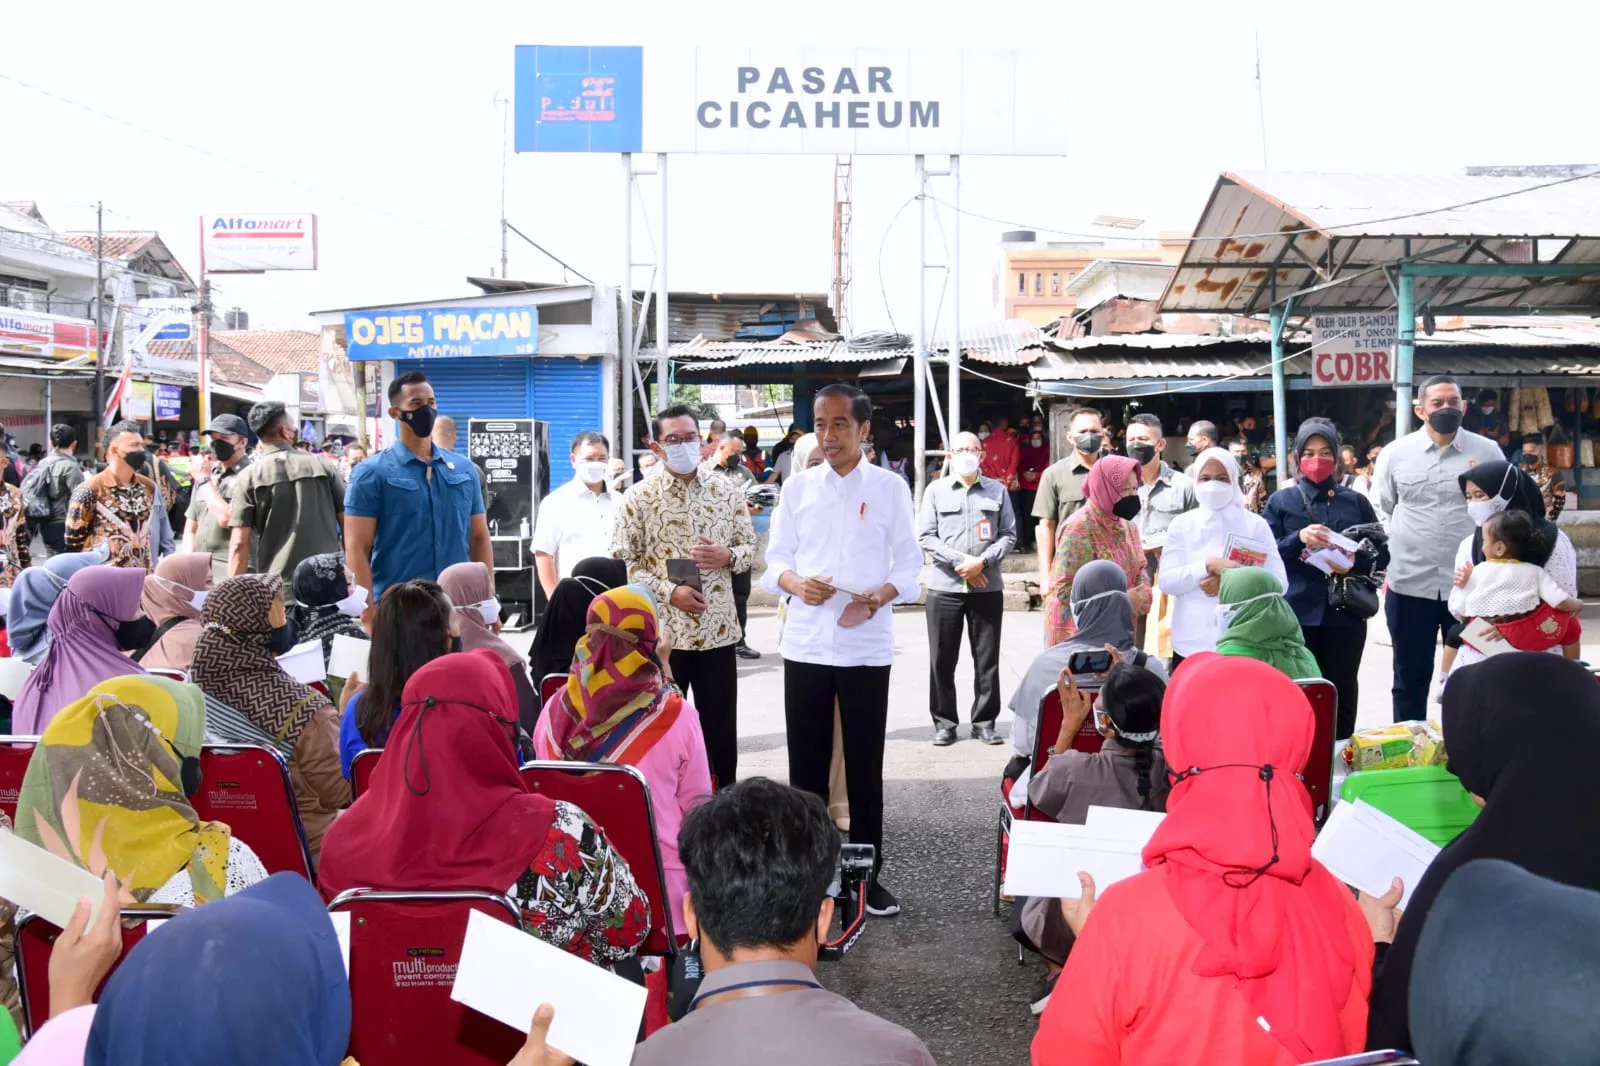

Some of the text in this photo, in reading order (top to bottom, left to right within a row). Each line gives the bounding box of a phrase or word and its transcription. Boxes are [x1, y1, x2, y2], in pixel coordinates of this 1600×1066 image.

[737, 66, 894, 95] PASAR
[697, 100, 940, 129] CICAHEUM
[212, 218, 304, 229] Alfamart
[352, 311, 532, 345] OJEG MACAN
[1322, 329, 1360, 338] GORENG
